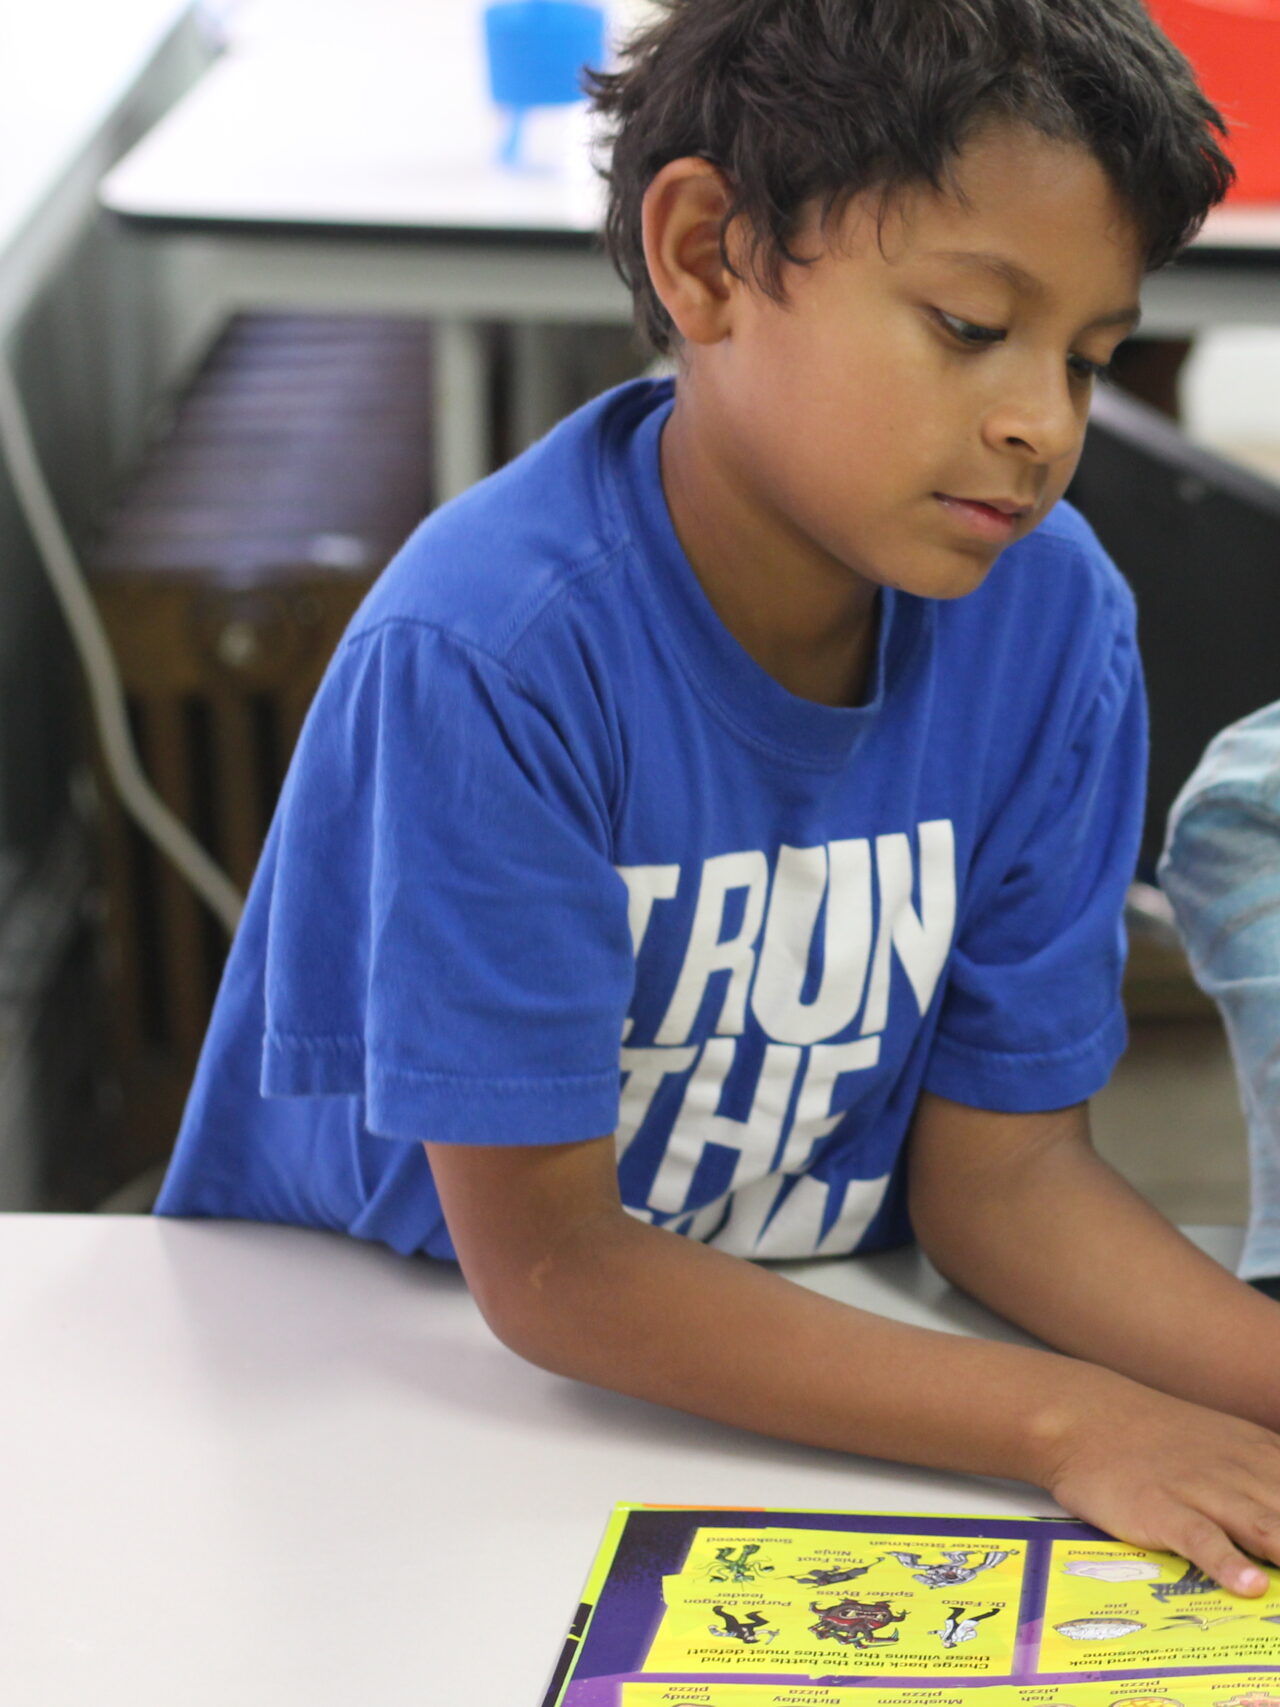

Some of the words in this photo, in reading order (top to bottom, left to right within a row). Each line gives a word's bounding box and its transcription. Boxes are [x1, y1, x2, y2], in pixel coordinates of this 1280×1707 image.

[653, 819, 957, 1046] RUN
[614, 1035, 881, 1214] THE
[869, 1541, 946, 1549] Stockman
[1068, 1550, 1146, 1558] Quicksand
[796, 1556, 831, 1564] Foot
[836, 1556, 864, 1564] This
[816, 1590, 860, 1598] Bytes
[865, 1590, 914, 1598] Spider
[683, 1598, 738, 1606] Dragon
[687, 1648, 744, 1656] defeat!
[794, 1650, 849, 1658] Turtles
[1234, 1650, 1272, 1658] back
[770, 1658, 818, 1666] battle
[1142, 1654, 1177, 1662] park
[853, 1660, 886, 1668] into
[933, 1662, 989, 1670] Charge
[1120, 1680, 1160, 1688] pizza
[662, 1694, 710, 1702] Candy
[902, 1690, 942, 1698] pizza
[772, 1696, 840, 1705] Birthday
[877, 1698, 963, 1706] Mushroom
